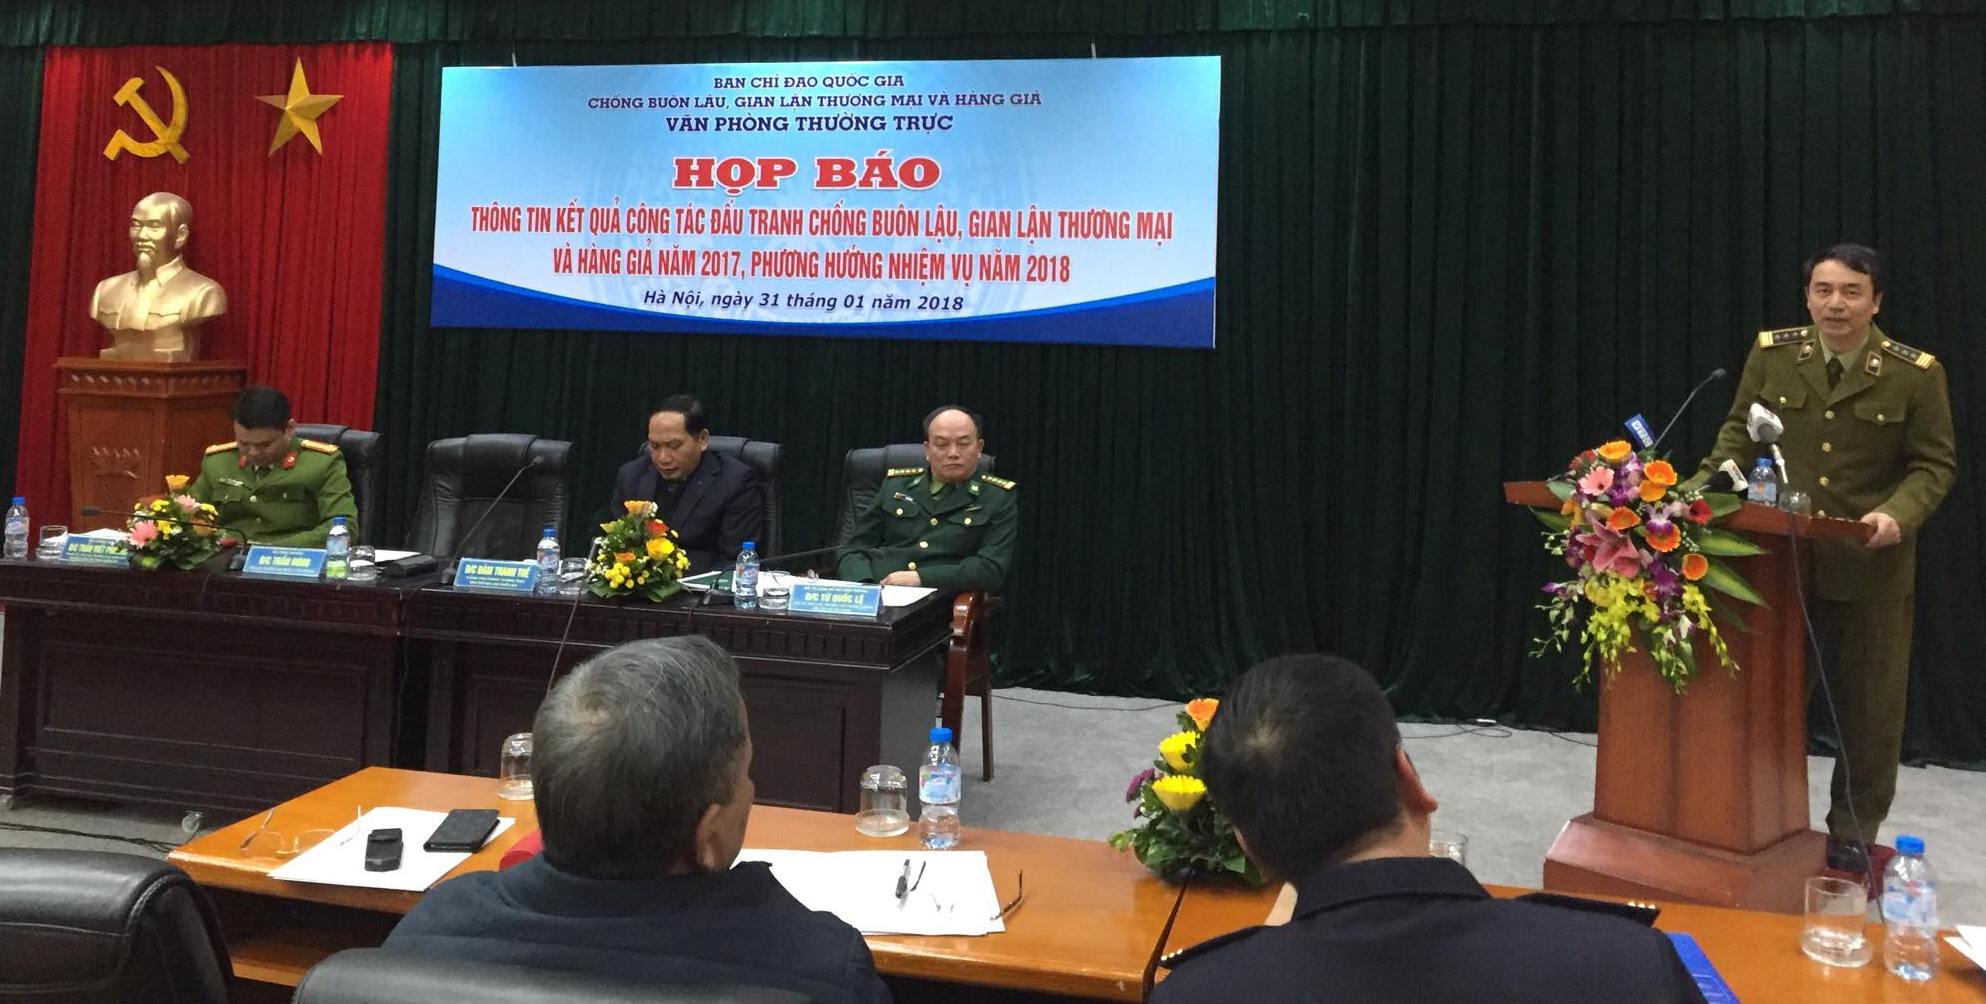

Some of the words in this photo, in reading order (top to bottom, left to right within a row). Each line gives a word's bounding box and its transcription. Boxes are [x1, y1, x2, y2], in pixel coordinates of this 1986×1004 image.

[714, 77, 746, 89] BAN
[874, 75, 904, 87] GIA
[588, 93, 644, 108] CHỐNG
[647, 94, 691, 108] BUÔN
[735, 96, 774, 108] GIAN
[780, 93, 812, 111] LẬN
[817, 93, 885, 107] THƯƠNG
[890, 95, 922, 110] MẠI
[927, 91, 950, 106] VÀ
[955, 90, 1005, 106] HÀNG
[666, 114, 709, 132] VĂN
[715, 113, 789, 132] PHÒNG
[795, 112, 887, 131] THƯỜNG
[893, 112, 953, 134] TRỰC
[673, 157, 797, 195] HỌP
[814, 149, 941, 190] BÁO
[472, 203, 521, 232] THÔNG
[526, 206, 551, 233] TIN
[556, 199, 585, 233] KẾT
[589, 197, 621, 236] QUẢ
[626, 203, 670, 234] CÔNG
[675, 203, 706, 235] TÁC
[710, 199, 743, 235] ĐẤU
[749, 208, 803, 235] TRANH
[809, 199, 866, 236] CHỐNG
[872, 203, 918, 237] BUÔN
[925, 204, 963, 243] LẬU,
[969, 210, 1011, 238] GIAN
[1016, 205, 1052, 244] LẬN
[1057, 210, 1130, 239] THƯƠNG
[1137, 211, 1173, 246] MẠI
[553, 242, 572, 274] VÀ
[578, 242, 620, 275] HÀNG
[626, 238, 652, 275] GIẢ
[659, 244, 696, 276] NĂM
[701, 250, 745, 279] 2017,
[751, 248, 818, 278] PHƯƠNG
[825, 244, 882, 280] HƯỚNG
[889, 248, 944, 286] NHIỆM
[951, 253, 972, 287] VỤ
[979, 248, 1020, 282] NĂM
[1026, 254, 1070, 283] 2018
[643, 290, 666, 304] Hà
[672, 290, 705, 307] Nội,
[711, 292, 753, 308] ngày
[758, 293, 779, 306] 31
[787, 292, 837, 311] tháng
[843, 294, 865, 309] 01
[871, 295, 910, 310] năm
[917, 296, 964, 310] 2018
